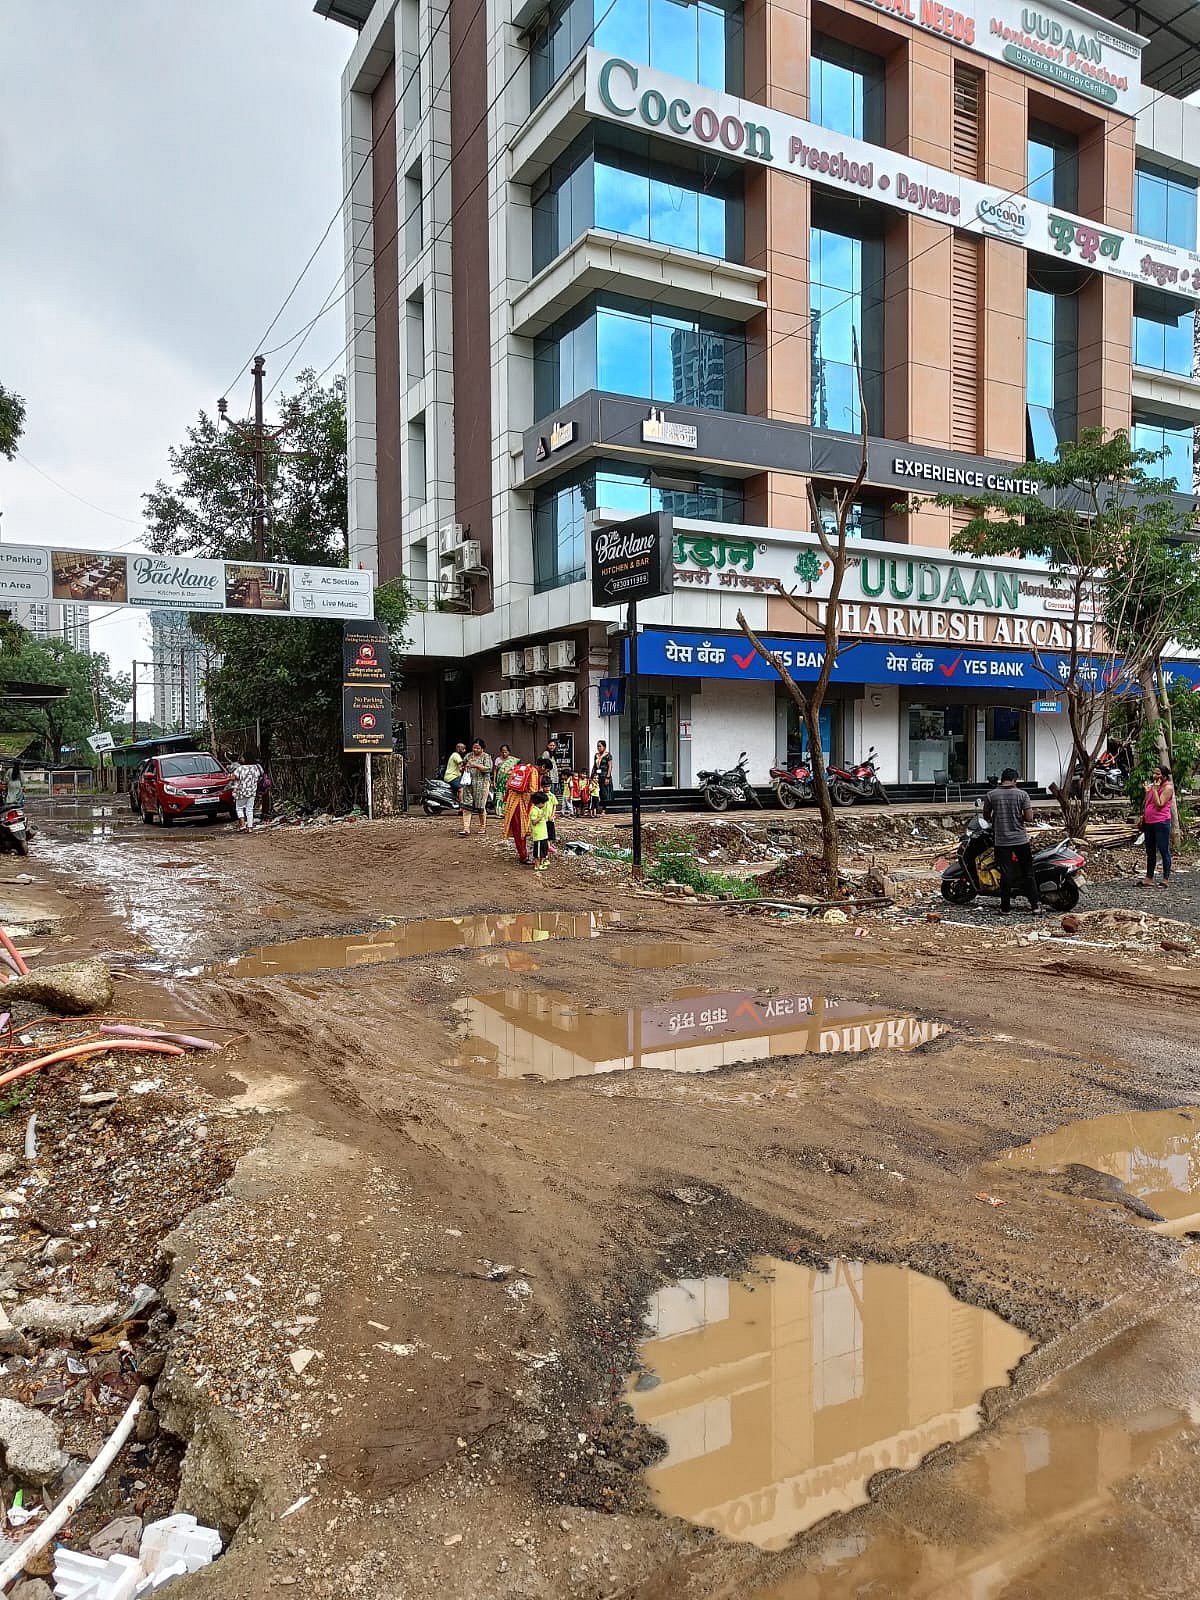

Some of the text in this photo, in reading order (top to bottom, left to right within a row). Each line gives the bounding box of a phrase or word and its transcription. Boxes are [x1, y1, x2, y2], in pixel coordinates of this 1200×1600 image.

[920, 0, 975, 45] NEEDS
[1021, 8, 1102, 64] UUDAAN
[1015, 50, 1048, 71] Daycare
[1055, 68, 1084, 89] Therapy
[1084, 80, 1109, 96] Center
[1066, 51, 1129, 91] Preschool
[598, 57, 961, 217] Cocoon Preschool Daycare
[980, 199, 1025, 226] Cocoon
[894, 458, 1039, 496] EXPERIENCE CENTER
[6, 554, 42, 566] Parking
[595, 532, 656, 564] Backlane
[133, 557, 220, 591] Backlane
[601, 561, 629, 577] KITCHEN
[635, 557, 649, 568] BAR
[9, 581, 32, 589] Area
[320, 577, 359, 586] AC Section
[860, 557, 1019, 609] UUDAAN
[1018, 580, 1073, 601] Montessor
[322, 599, 358, 609] Live Music
[816, 601, 987, 642] DHARMESH
[665, 639, 726, 664] येस बँक
[796, 651, 839, 669] BAN
[886, 651, 935, 673] येस बँक
[963, 659, 1024, 677] YES BANK
[601, 700, 616, 713] ATM
